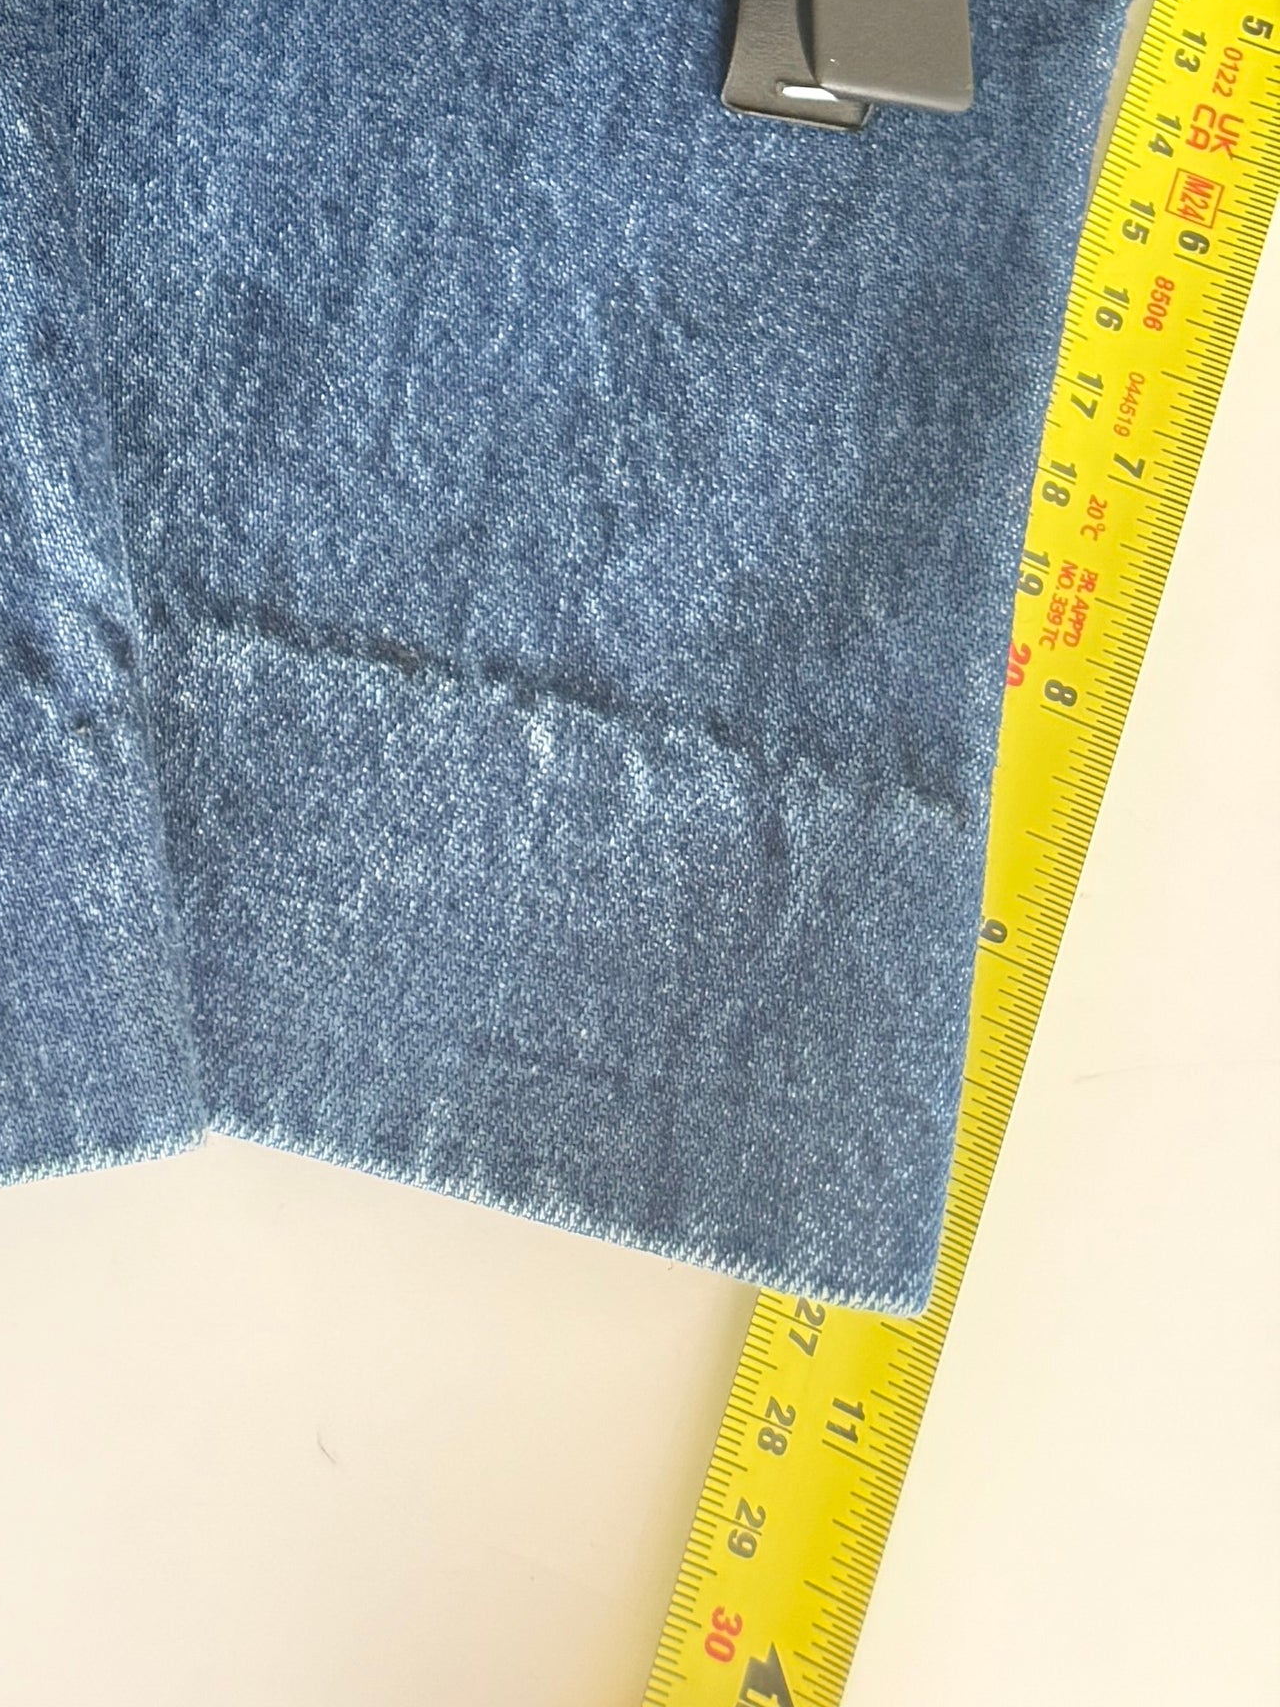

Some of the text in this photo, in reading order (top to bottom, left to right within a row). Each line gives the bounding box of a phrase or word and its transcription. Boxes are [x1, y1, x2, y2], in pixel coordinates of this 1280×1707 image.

[1174, 29, 1207, 73] 13
[1242, 15, 1274, 40] 5
[1212, 47, 1243, 98] 0122
[1148, 113, 1182, 158] 14
[1186, 103, 1216, 150] CA
[1210, 113, 1244, 160] UK
[1122, 199, 1156, 245] 15
[1177, 175, 1214, 223] M24
[1178, 229, 1210, 255] 6
[1095, 285, 1130, 332] 16
[1143, 276, 1175, 332] 8506
[1070, 371, 1104, 419] 17
[1113, 371, 1145, 438] 044519
[1042, 460, 1077, 507] 18
[1113, 453, 1146, 479] 7
[1018, 549, 1050, 596] 19
[1044, 678, 1077, 707] 8
[787, 1298, 825, 1357] 27
[758, 1396, 796, 1457] 28
[826, 1396, 865, 1444] 11
[728, 1497, 766, 1559] 29
[704, 1604, 743, 1663] 30
